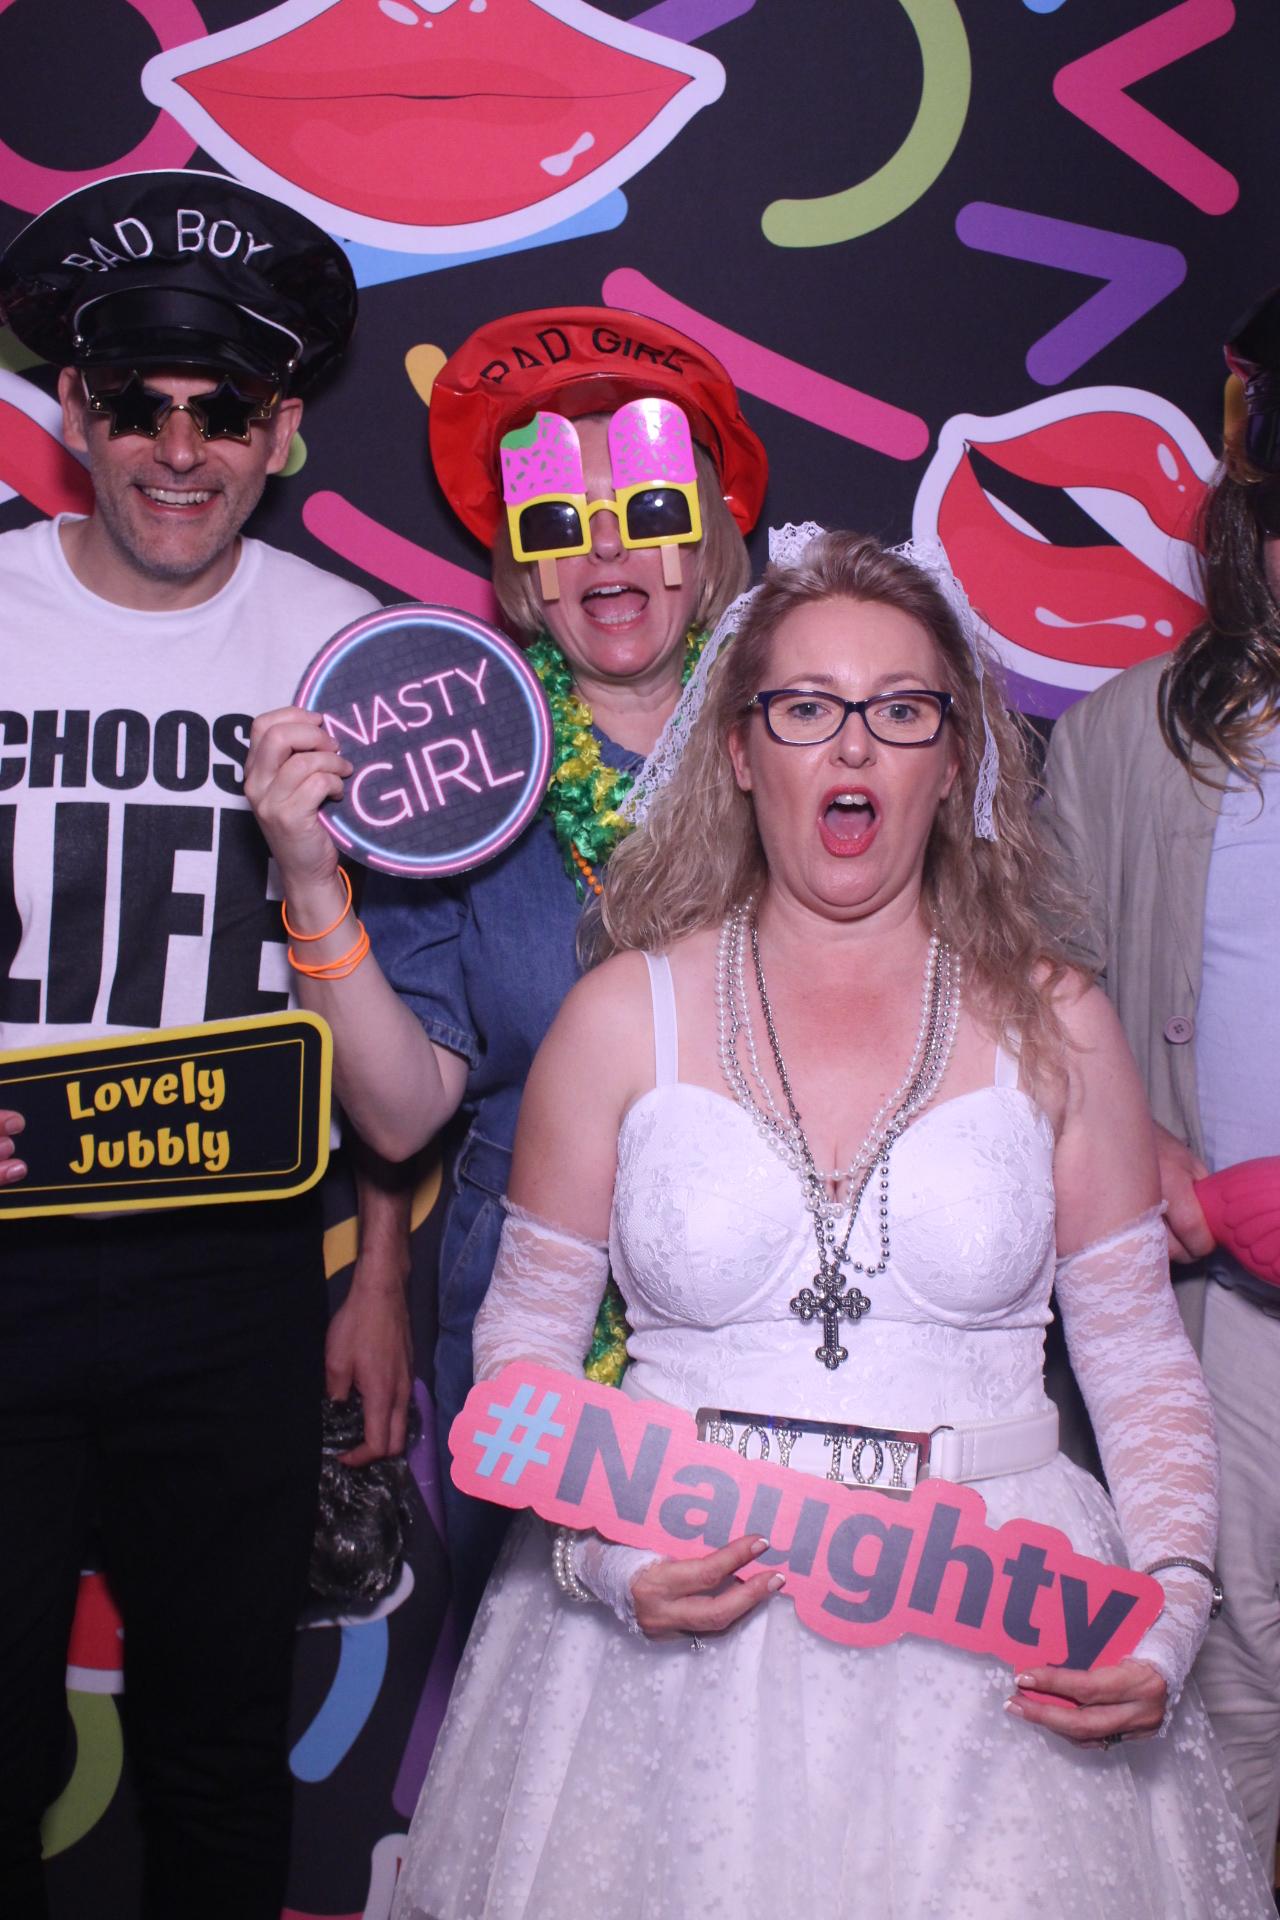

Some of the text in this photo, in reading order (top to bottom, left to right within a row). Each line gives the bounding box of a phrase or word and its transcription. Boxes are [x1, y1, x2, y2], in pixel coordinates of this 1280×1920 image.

[61, 208, 274, 272] BAD BOY
[591, 327, 693, 374] GIRL
[322, 657, 488, 756] NASTY
[0, 708, 257, 797] CHOOS
[351, 728, 526, 827] GIRL
[0, 801, 290, 1029] LIFE
[66, 1061, 227, 1121] Lovely
[69, 1122, 231, 1175] Jubbly
[823, 1432, 917, 1489] TOY
[472, 1382, 1139, 1671] #Naughty
